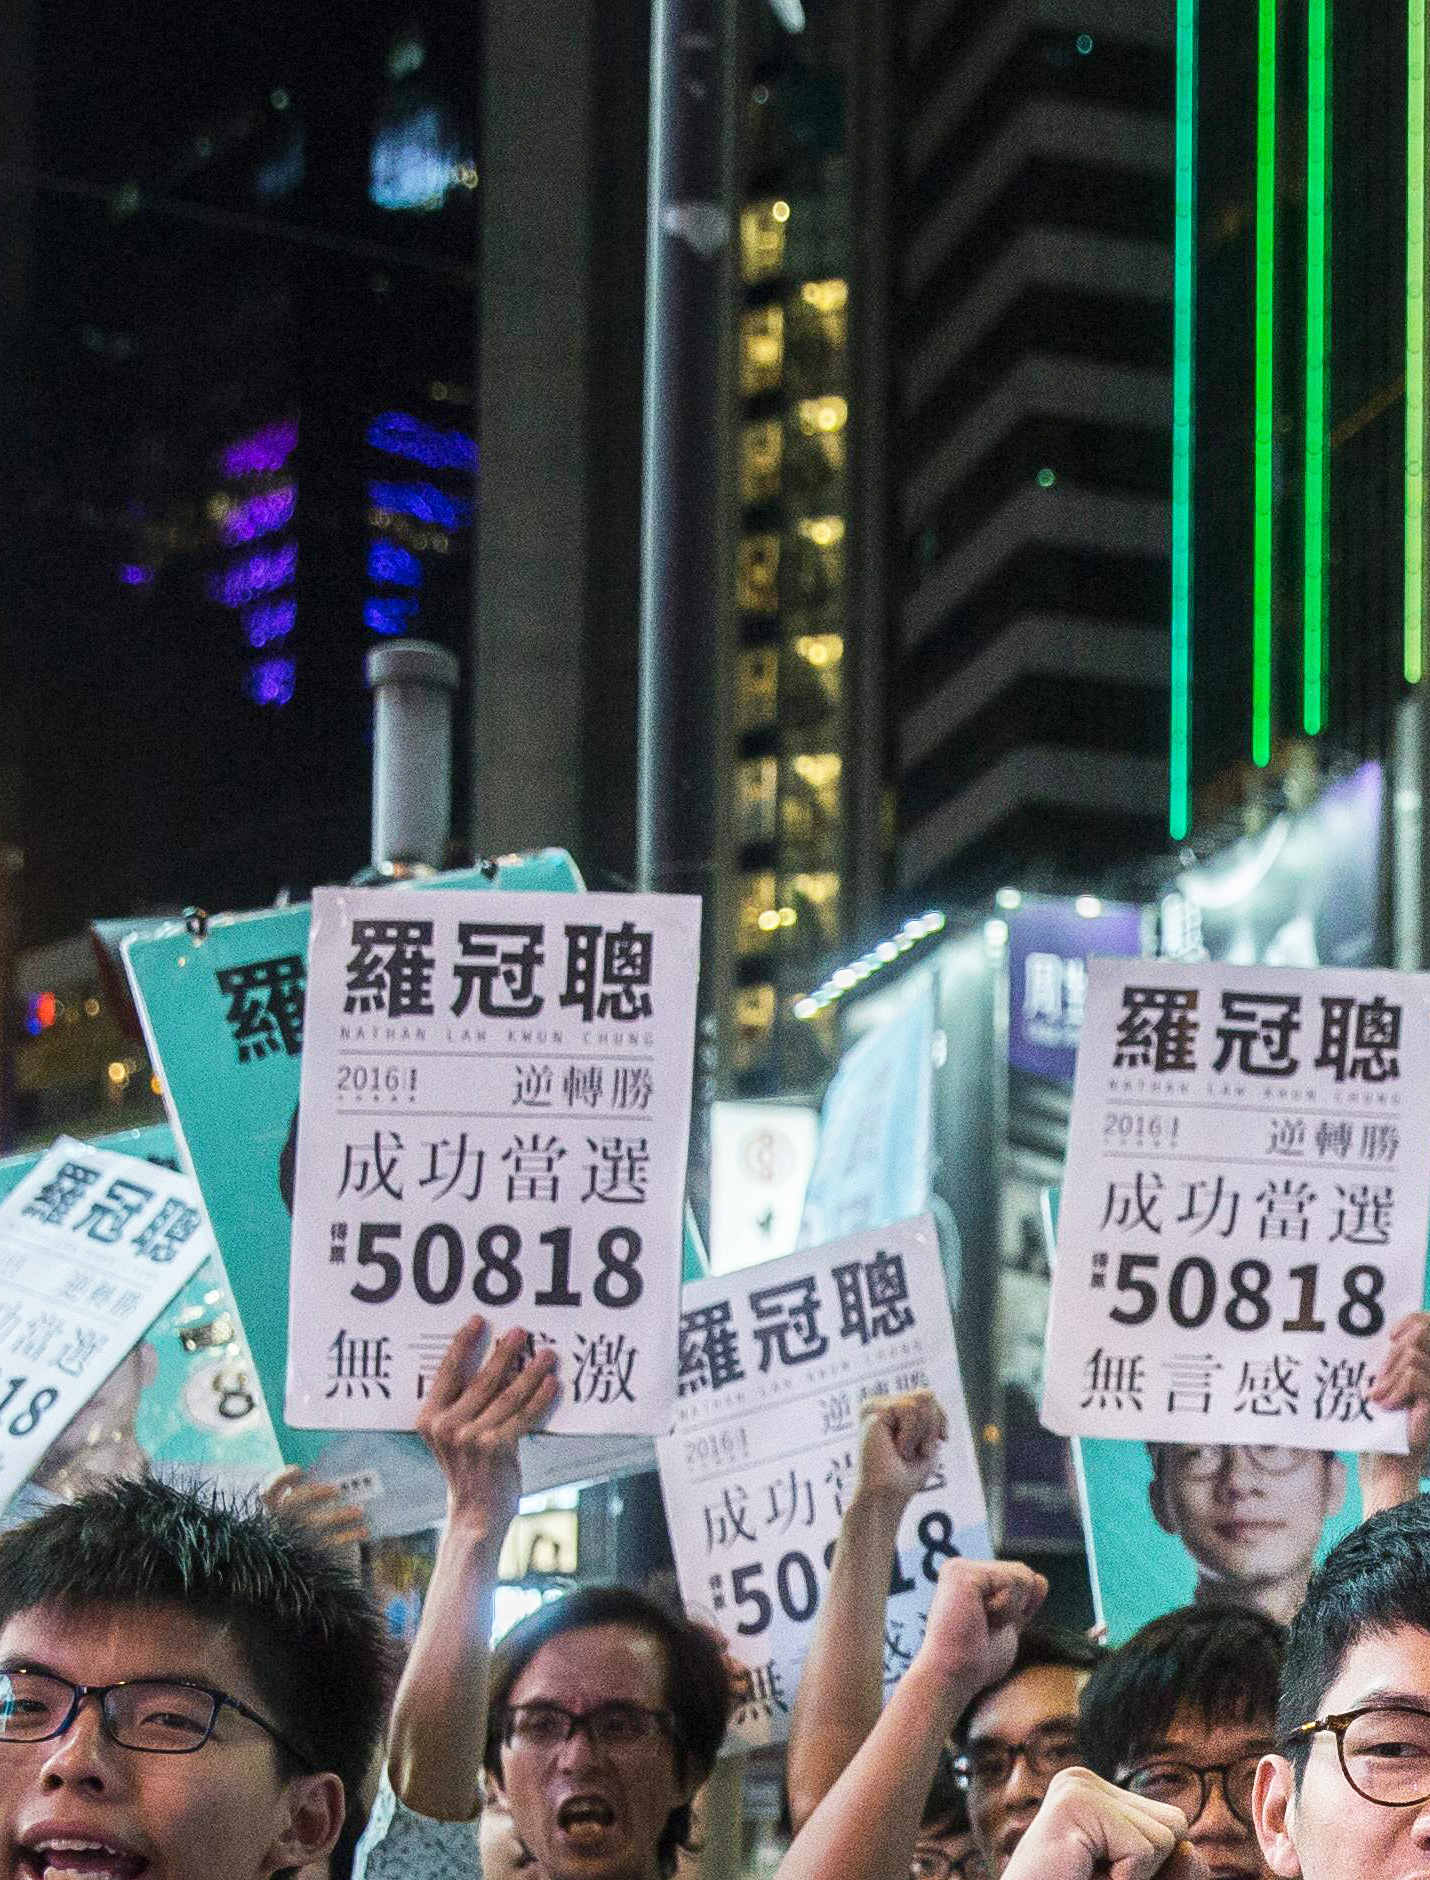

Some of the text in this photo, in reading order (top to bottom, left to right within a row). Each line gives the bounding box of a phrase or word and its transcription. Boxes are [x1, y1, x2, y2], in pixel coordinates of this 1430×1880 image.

[343, 918, 654, 1023] 羅冠聰
[340, 1027, 427, 1040] NATHAN
[447, 1029, 487, 1041] LAW
[583, 1032, 655, 1045] CHUNG
[1113, 986, 1403, 1082] 羅冠聰
[337, 1065, 399, 1090] 2016
[511, 1065, 654, 1111] 逆轉勝
[1103, 1112, 1162, 1137] 2016
[1267, 1117, 1401, 1161] 逆轉勝
[336, 1130, 650, 1204] 成功當選
[22, 1161, 203, 1265] 羅冠聰
[1100, 1172, 1395, 1246] 成功當選
[349, 1222, 644, 1308] 50818
[1109, 1254, 1386, 1337] 50818
[677, 1250, 916, 1396] 羅冠聰
[1081, 1347, 1377, 1421] 無言感激
[731, 1511, 959, 1636] 508
